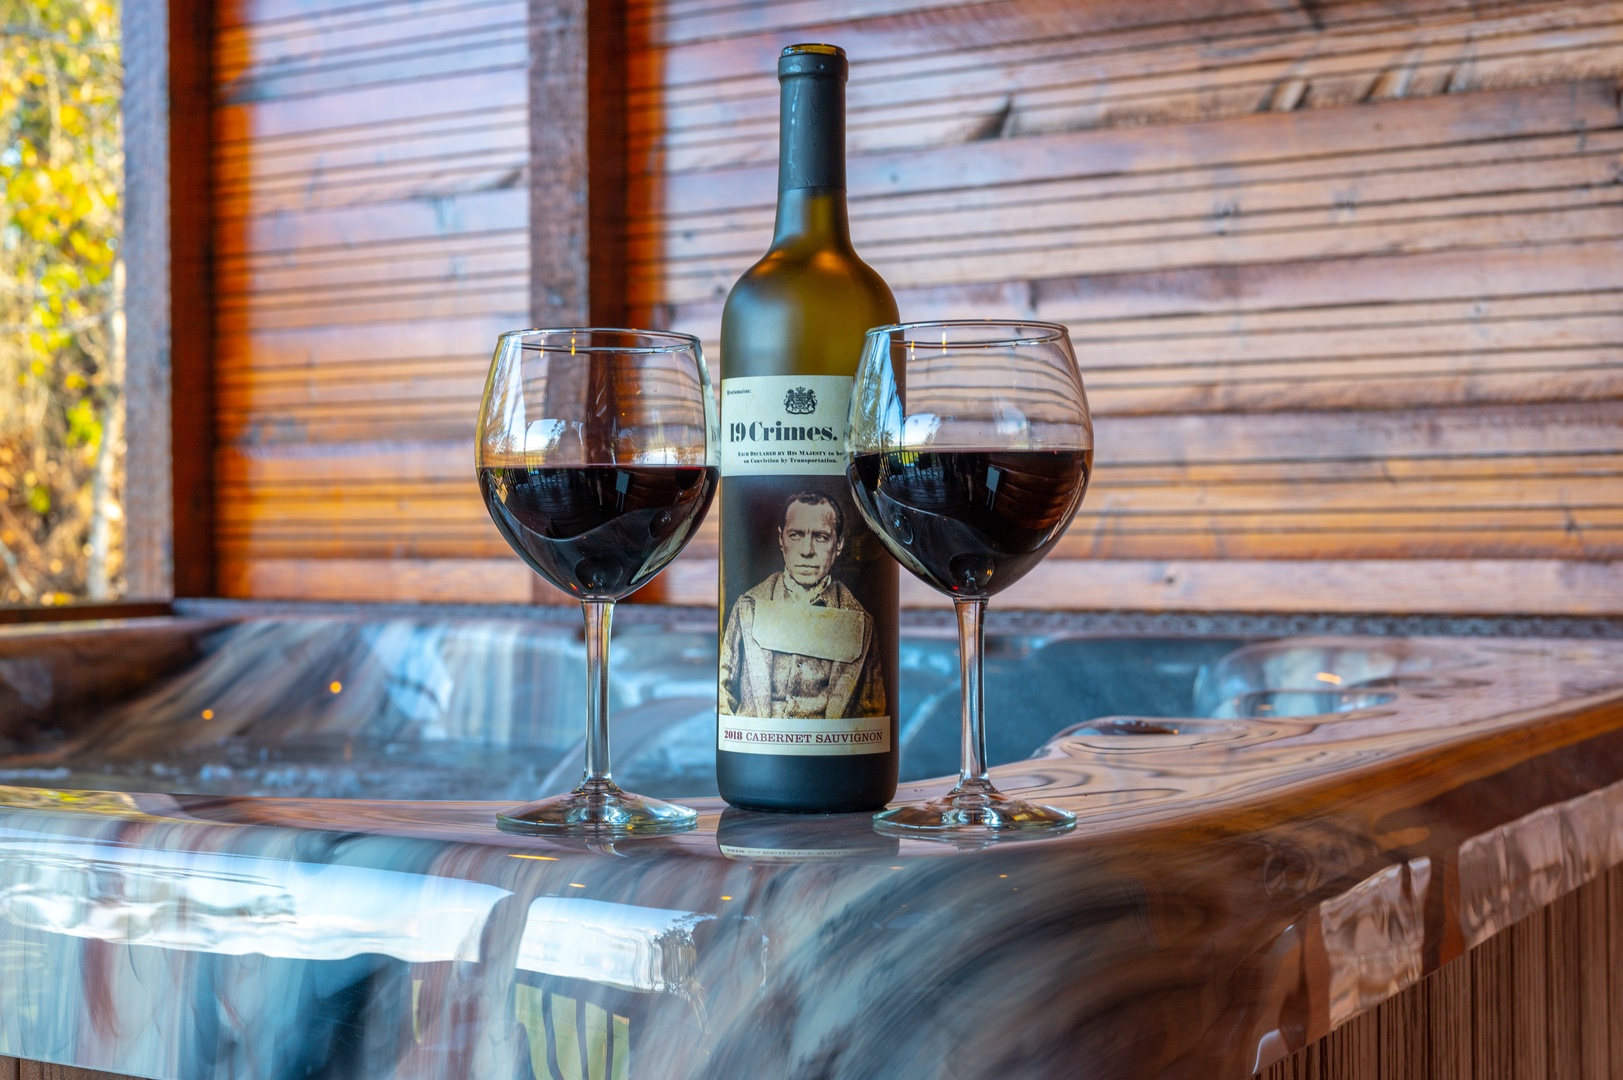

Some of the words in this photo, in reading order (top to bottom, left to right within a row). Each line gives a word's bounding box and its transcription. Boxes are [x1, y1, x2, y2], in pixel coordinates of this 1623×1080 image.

[749, 420, 838, 442] Crimes.
[724, 730, 743, 740] 2018
[746, 732, 812, 743] CABERNET
[815, 731, 883, 743] SAUVIGNON
